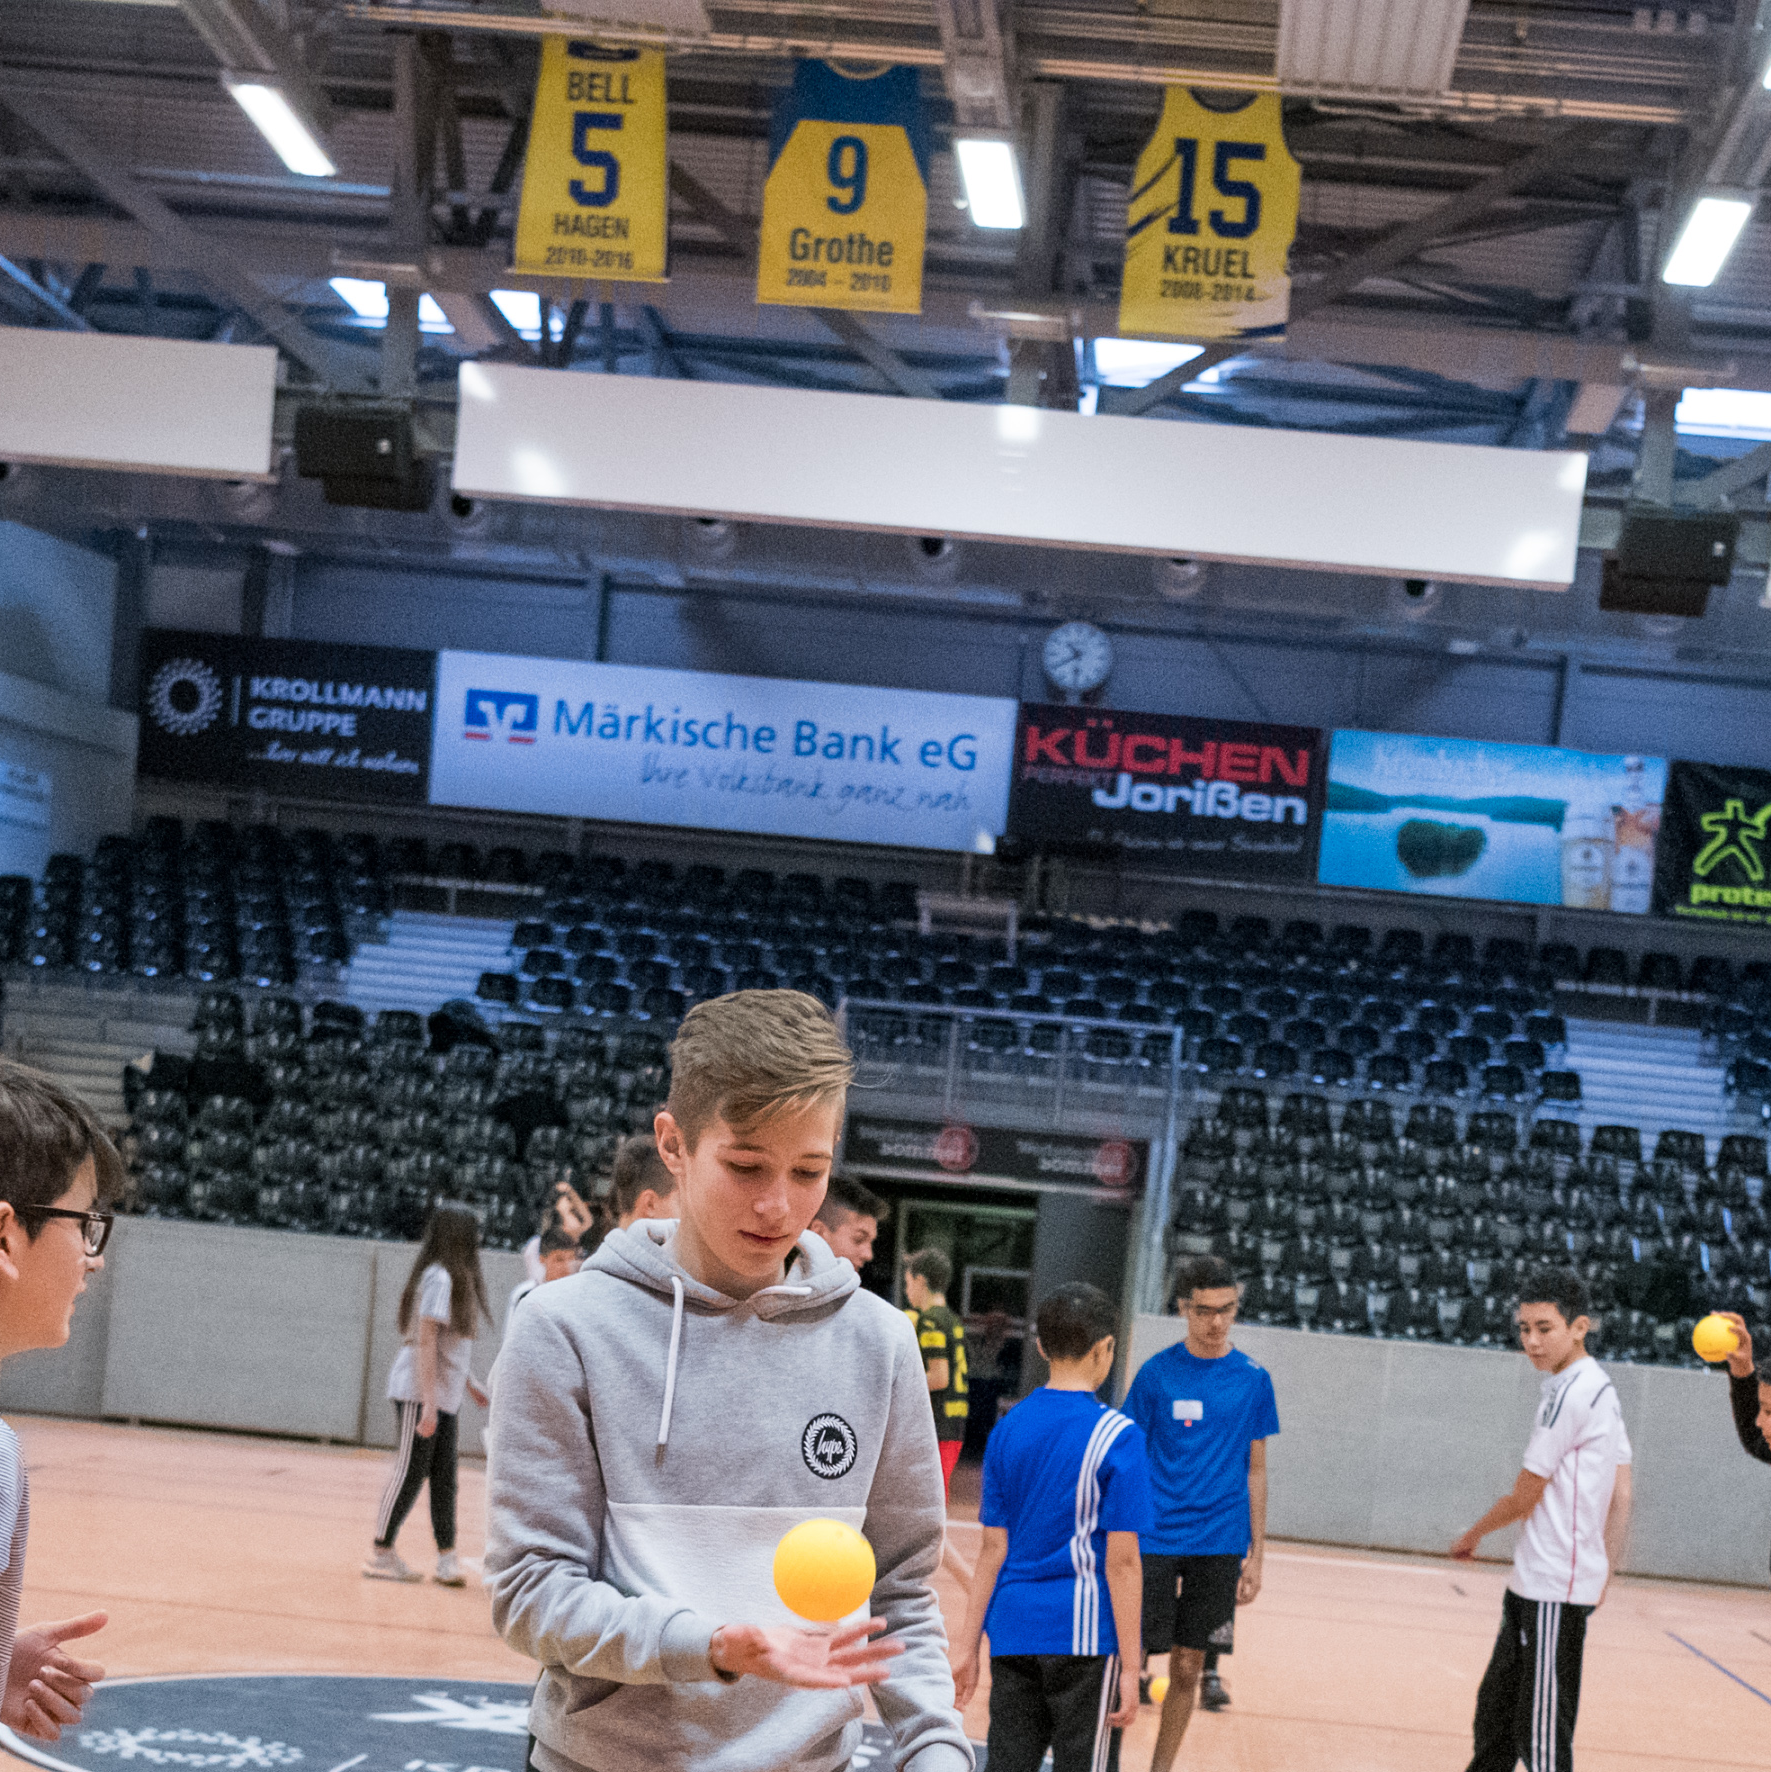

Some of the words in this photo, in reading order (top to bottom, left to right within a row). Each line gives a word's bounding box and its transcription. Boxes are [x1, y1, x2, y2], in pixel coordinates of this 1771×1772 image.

[567, 71, 636, 104] BELL
[569, 111, 624, 207] 5
[826, 134, 868, 215] 9
[1167, 137, 1267, 240] 15
[553, 213, 630, 240] HAGEN
[789, 227, 895, 268] Grothe
[1163, 245, 1255, 279] KRUEL
[249, 676, 428, 713] KROLLMANN
[247, 705, 358, 737] GRUPPE
[553, 698, 777, 754] Märkische
[793, 719, 902, 766] Bank
[918, 732, 978, 772] eG
[1025, 718, 1310, 786] KÜCHEN
[1091, 772, 1309, 826] Jorißen
